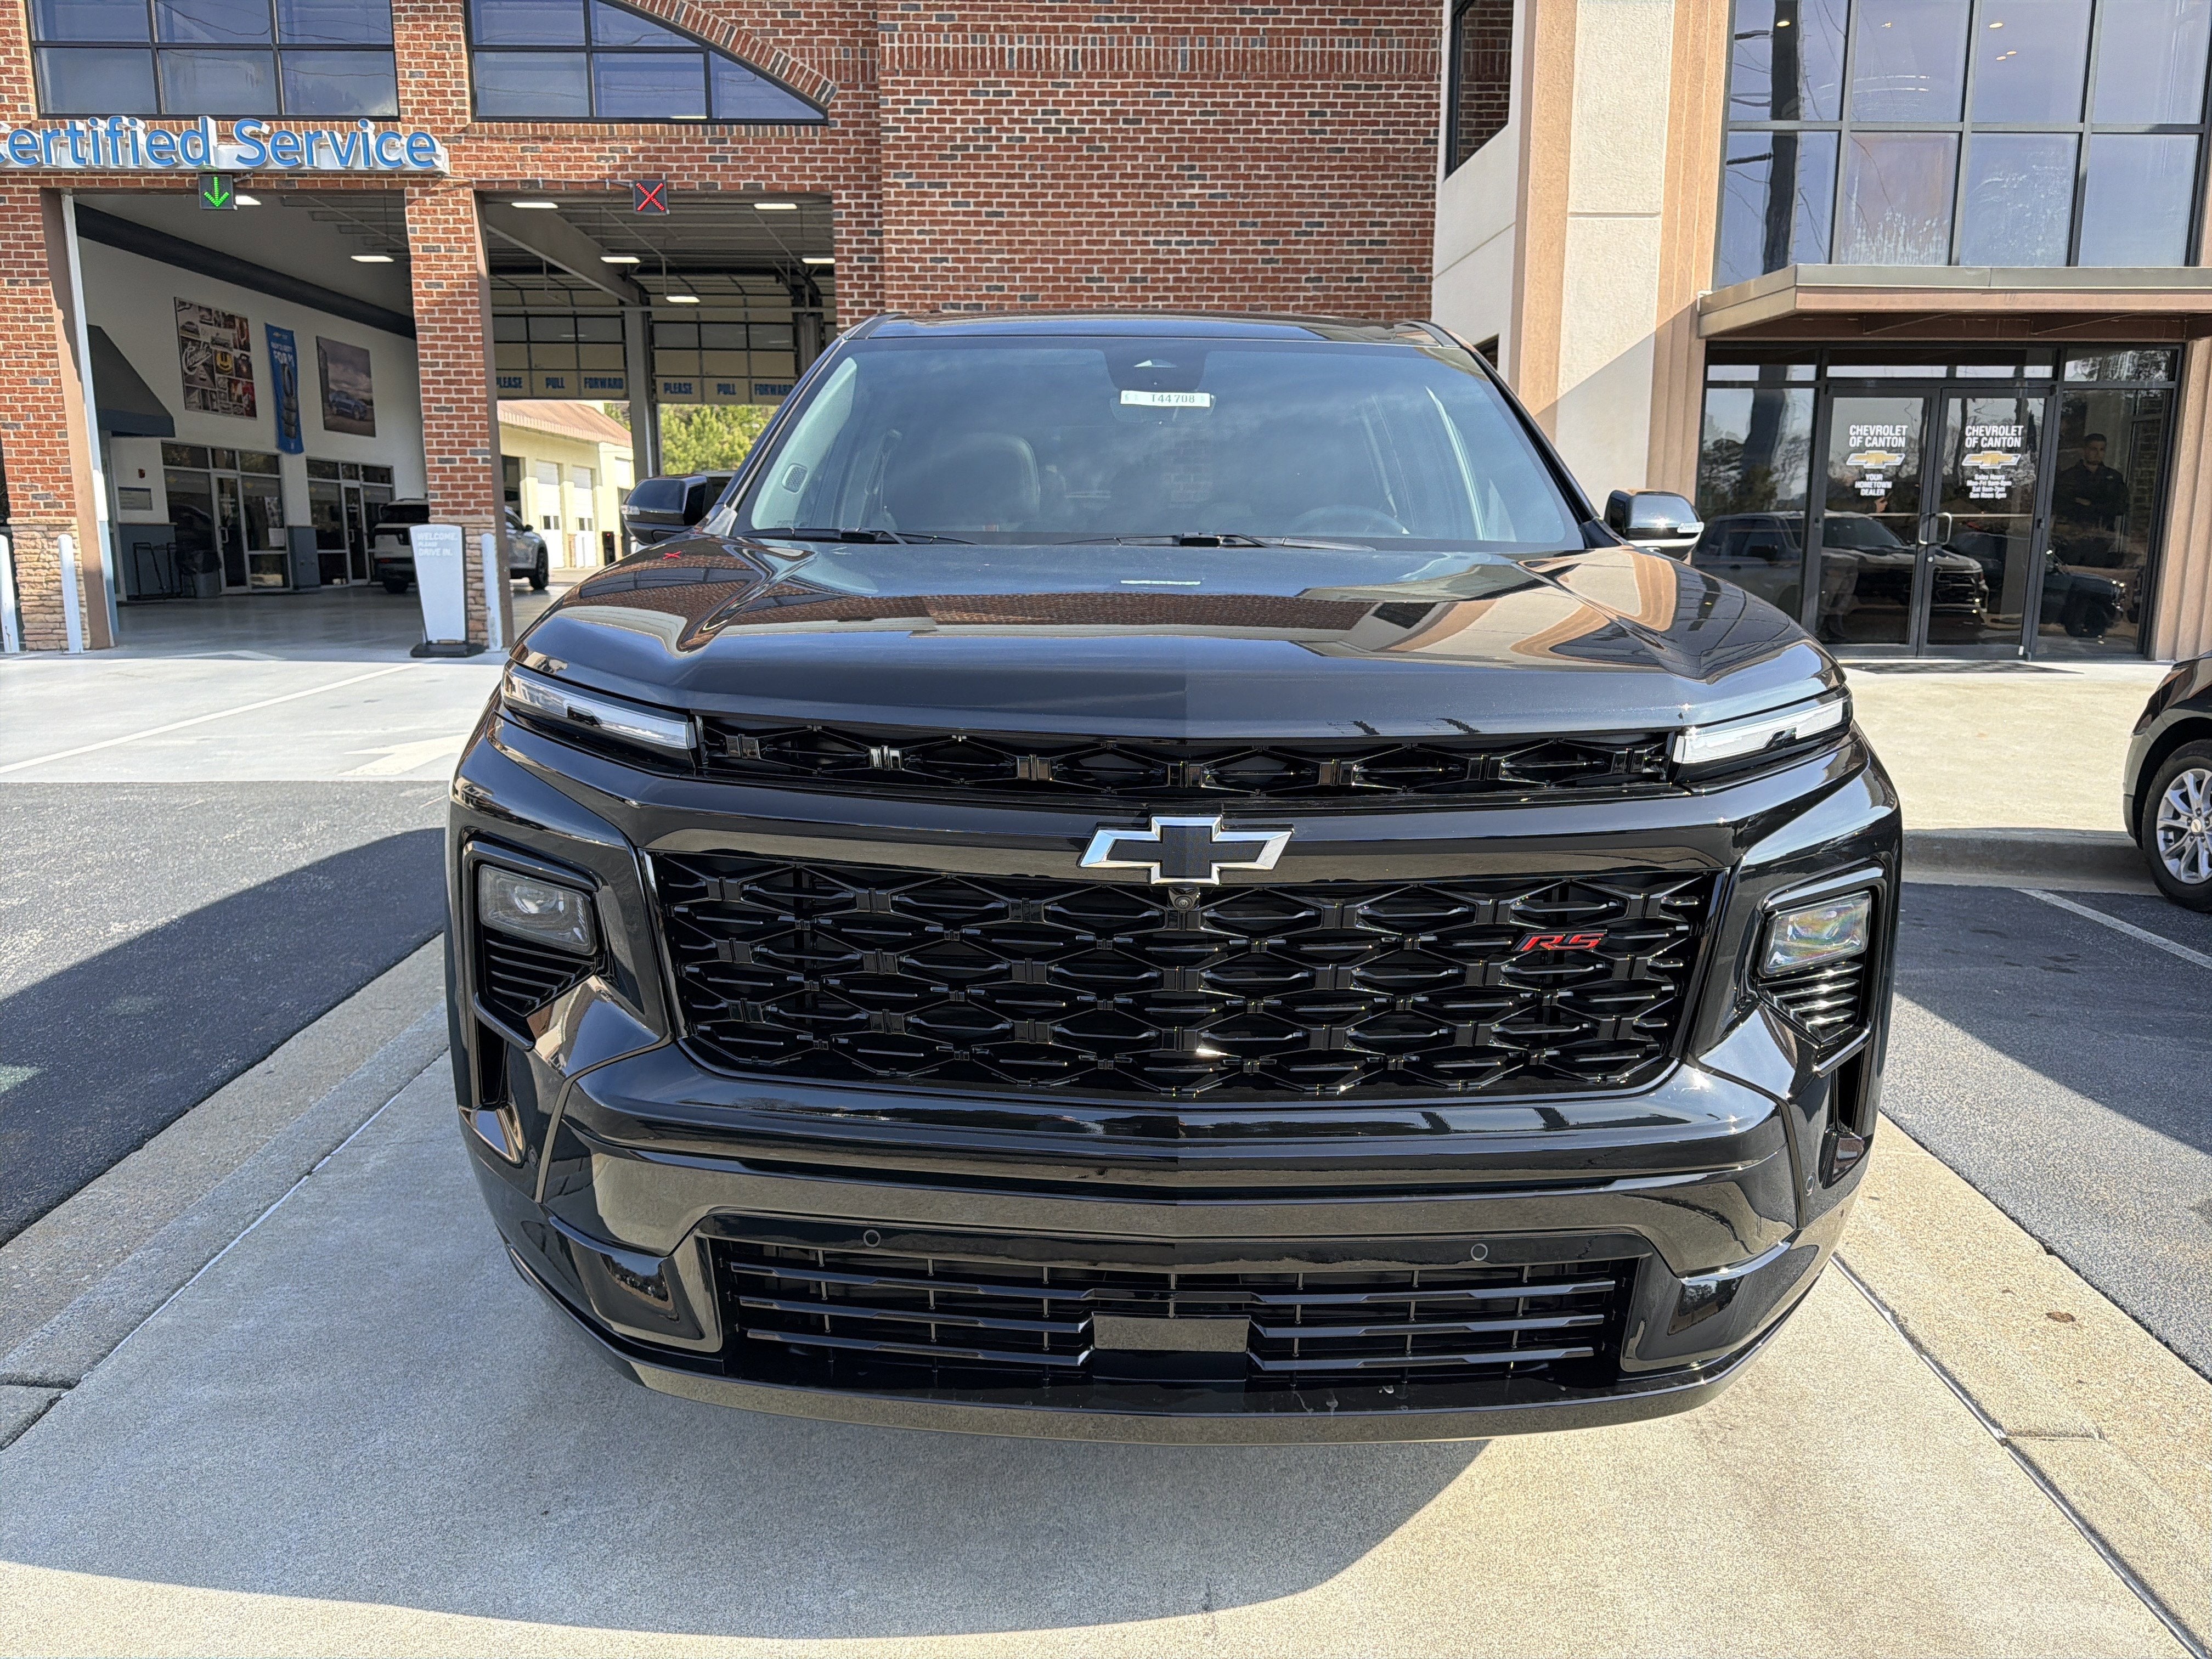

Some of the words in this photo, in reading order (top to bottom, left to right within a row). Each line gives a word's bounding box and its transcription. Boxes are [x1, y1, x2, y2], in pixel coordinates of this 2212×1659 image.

[0, 116, 215, 166] ertified
[233, 118, 440, 168] Service
[545, 377, 565, 389] PULL
[584, 377, 624, 389] FORWARD
[663, 382, 693, 394] PLEASE
[716, 383, 736, 395] PULL
[1150, 394, 1195, 403] T44708
[1849, 425, 1908, 436] CHEVROLET
[1965, 425, 2024, 436] CHEVROLET
[1849, 436, 1863, 448] OF
[1865, 436, 1906, 448] CANTON
[1965, 437, 1979, 448] OF
[1980, 437, 2022, 448] CANTON
[419, 548, 441, 556] DRIVE
[1517, 933, 1605, 951] RS
